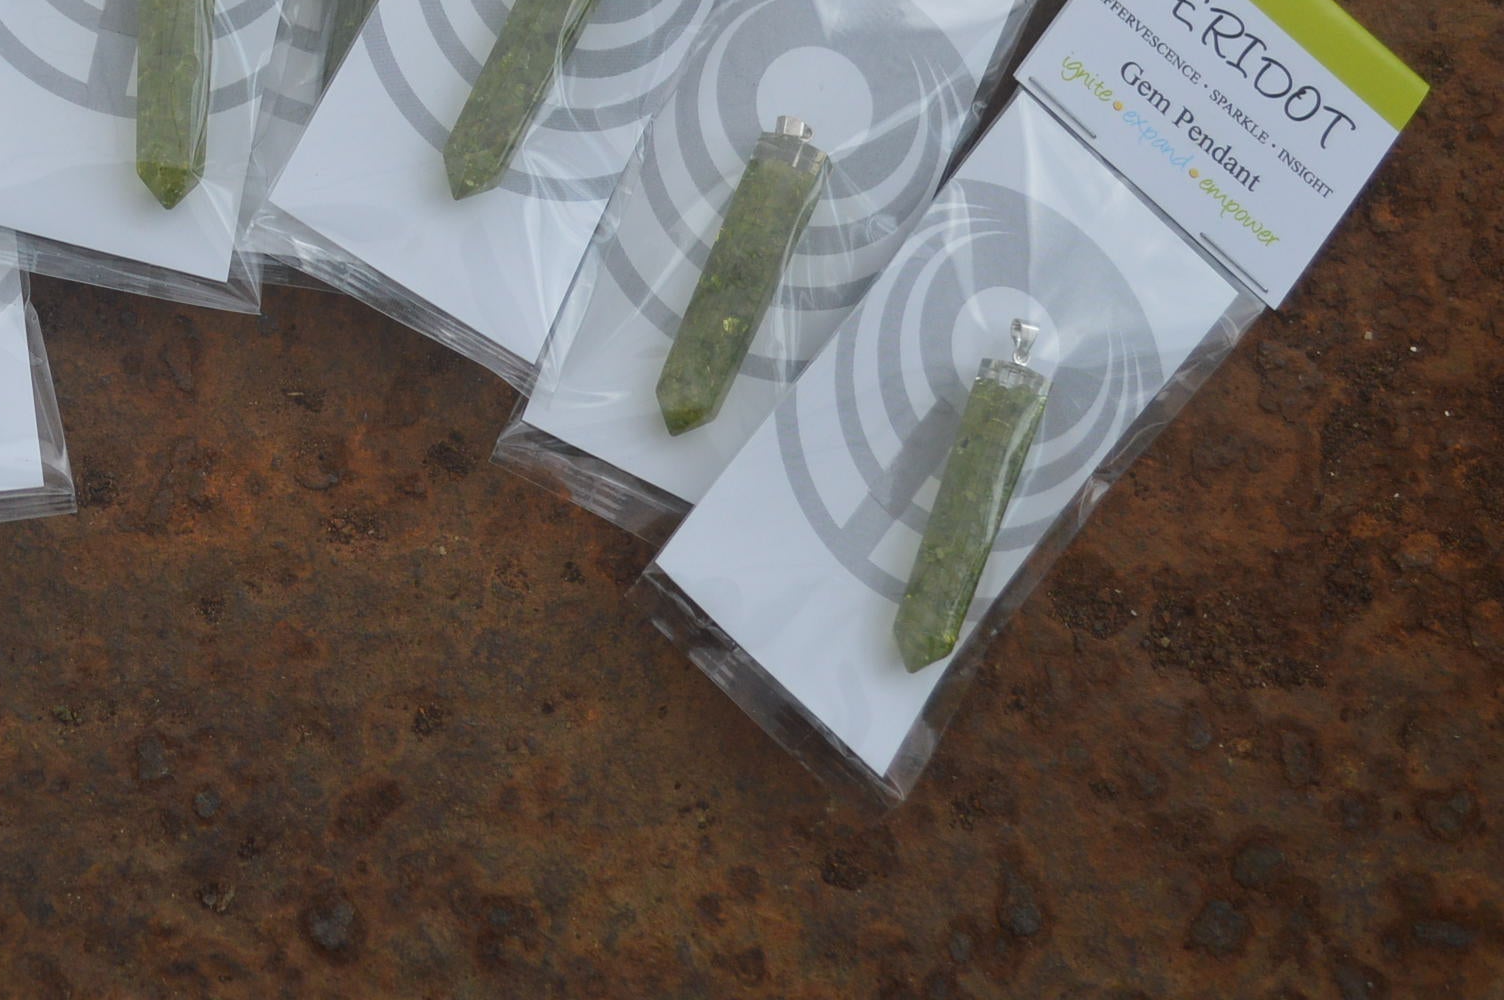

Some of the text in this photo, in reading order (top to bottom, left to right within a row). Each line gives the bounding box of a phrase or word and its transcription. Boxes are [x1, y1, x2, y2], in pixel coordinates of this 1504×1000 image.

[1061, 52, 1280, 247] ignite expand empower
[1120, 60, 1262, 192] Gem Pendant
[1209, 89, 1271, 145] SPARKLE
[1278, 147, 1335, 199] INSIGHT
